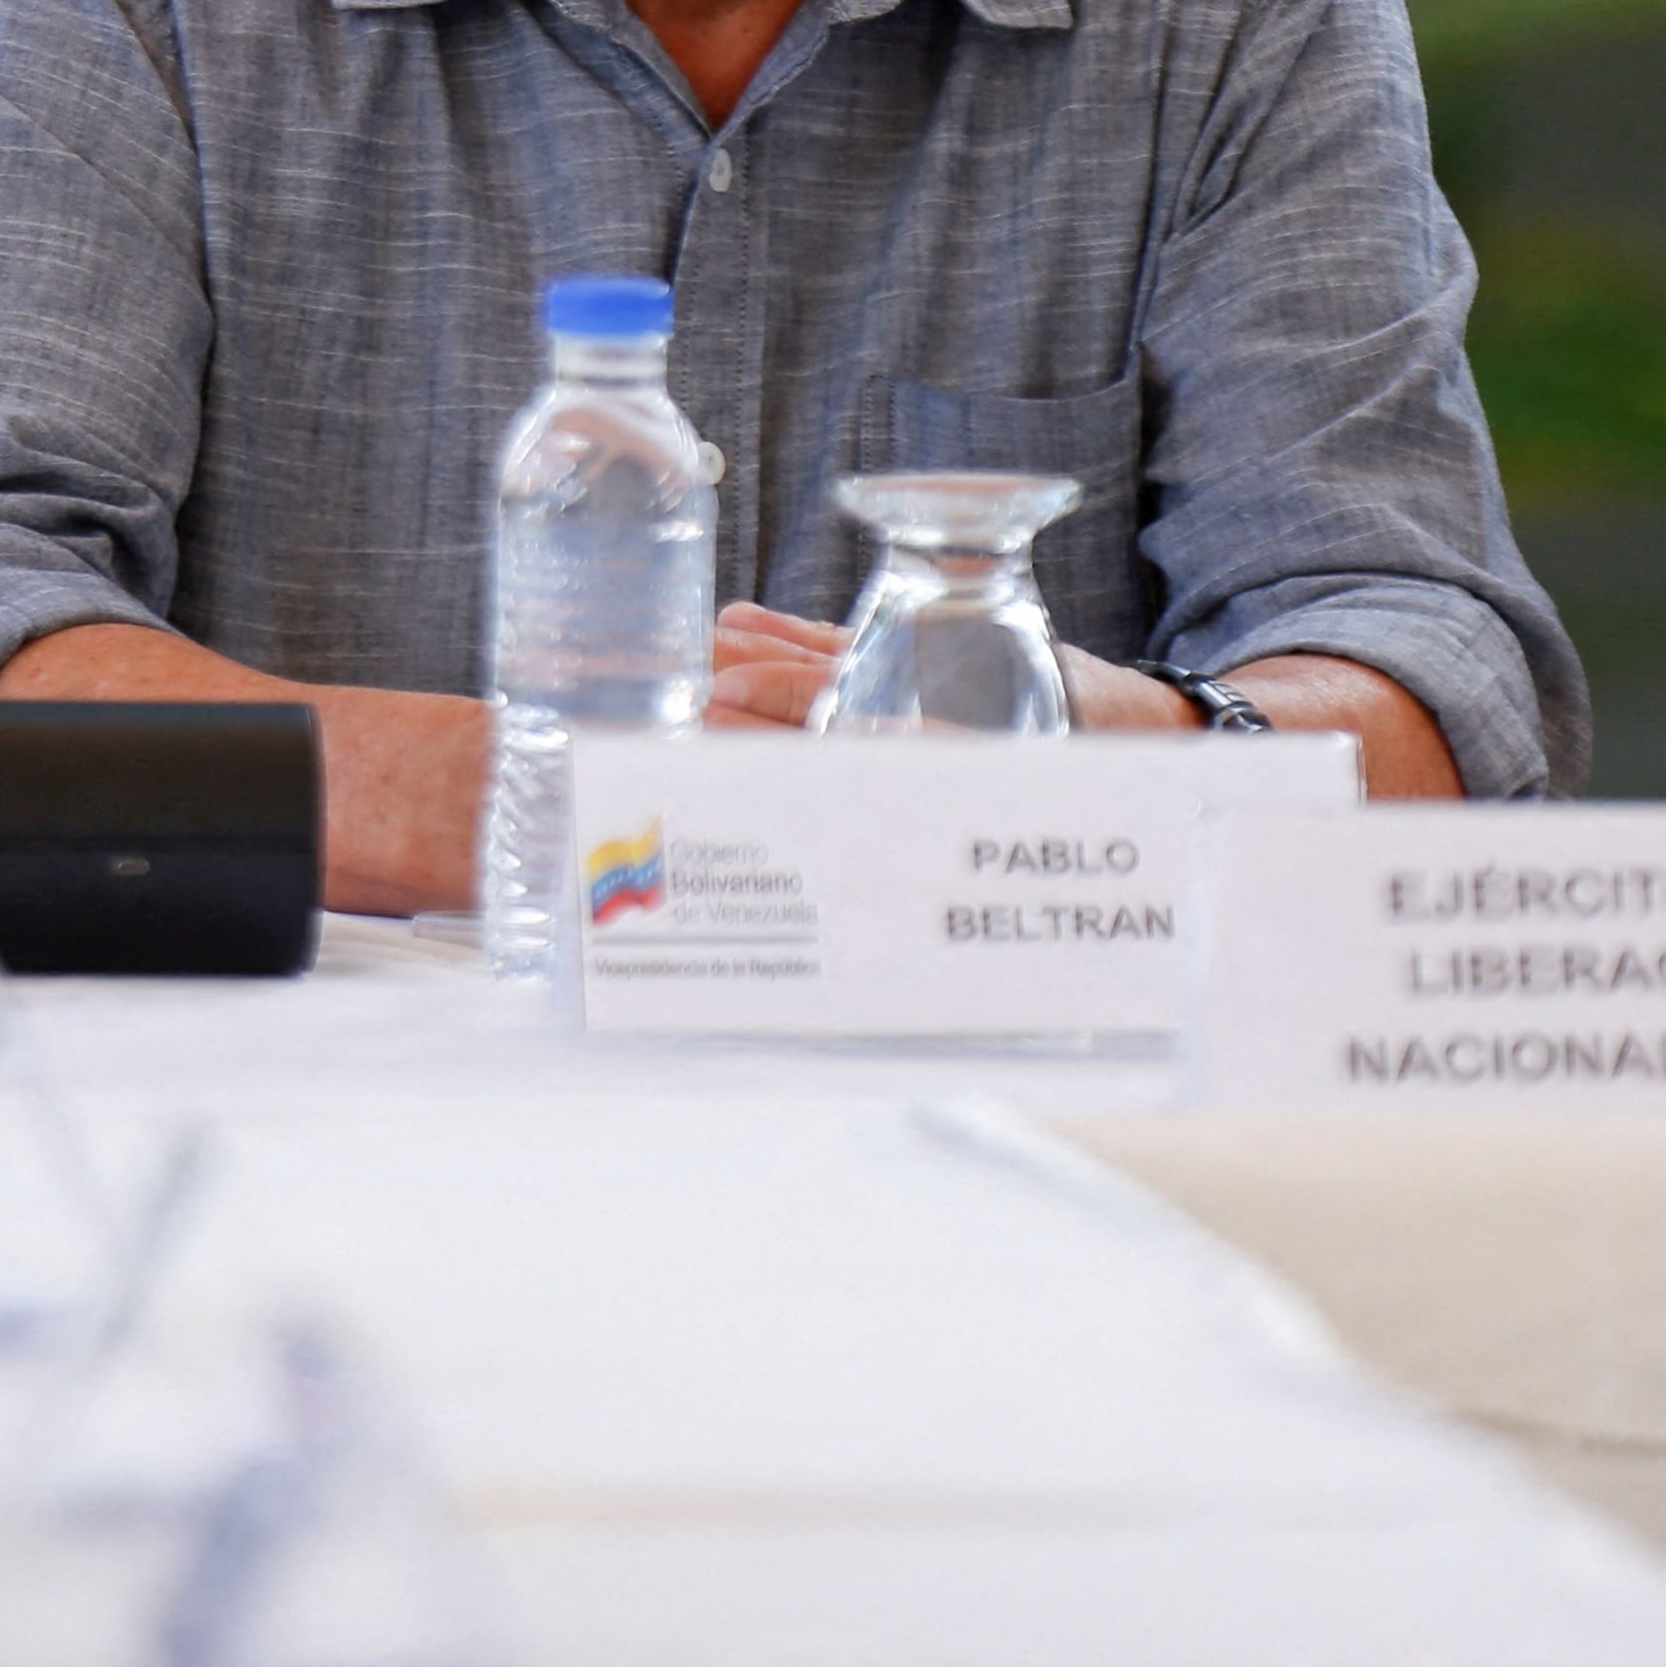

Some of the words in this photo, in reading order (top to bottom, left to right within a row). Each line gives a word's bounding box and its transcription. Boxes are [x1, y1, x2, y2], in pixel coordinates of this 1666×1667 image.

[972, 838, 1140, 875] PABLO
[671, 867, 804, 896] Bolivariano
[946, 905, 1176, 941] BELTRAN
